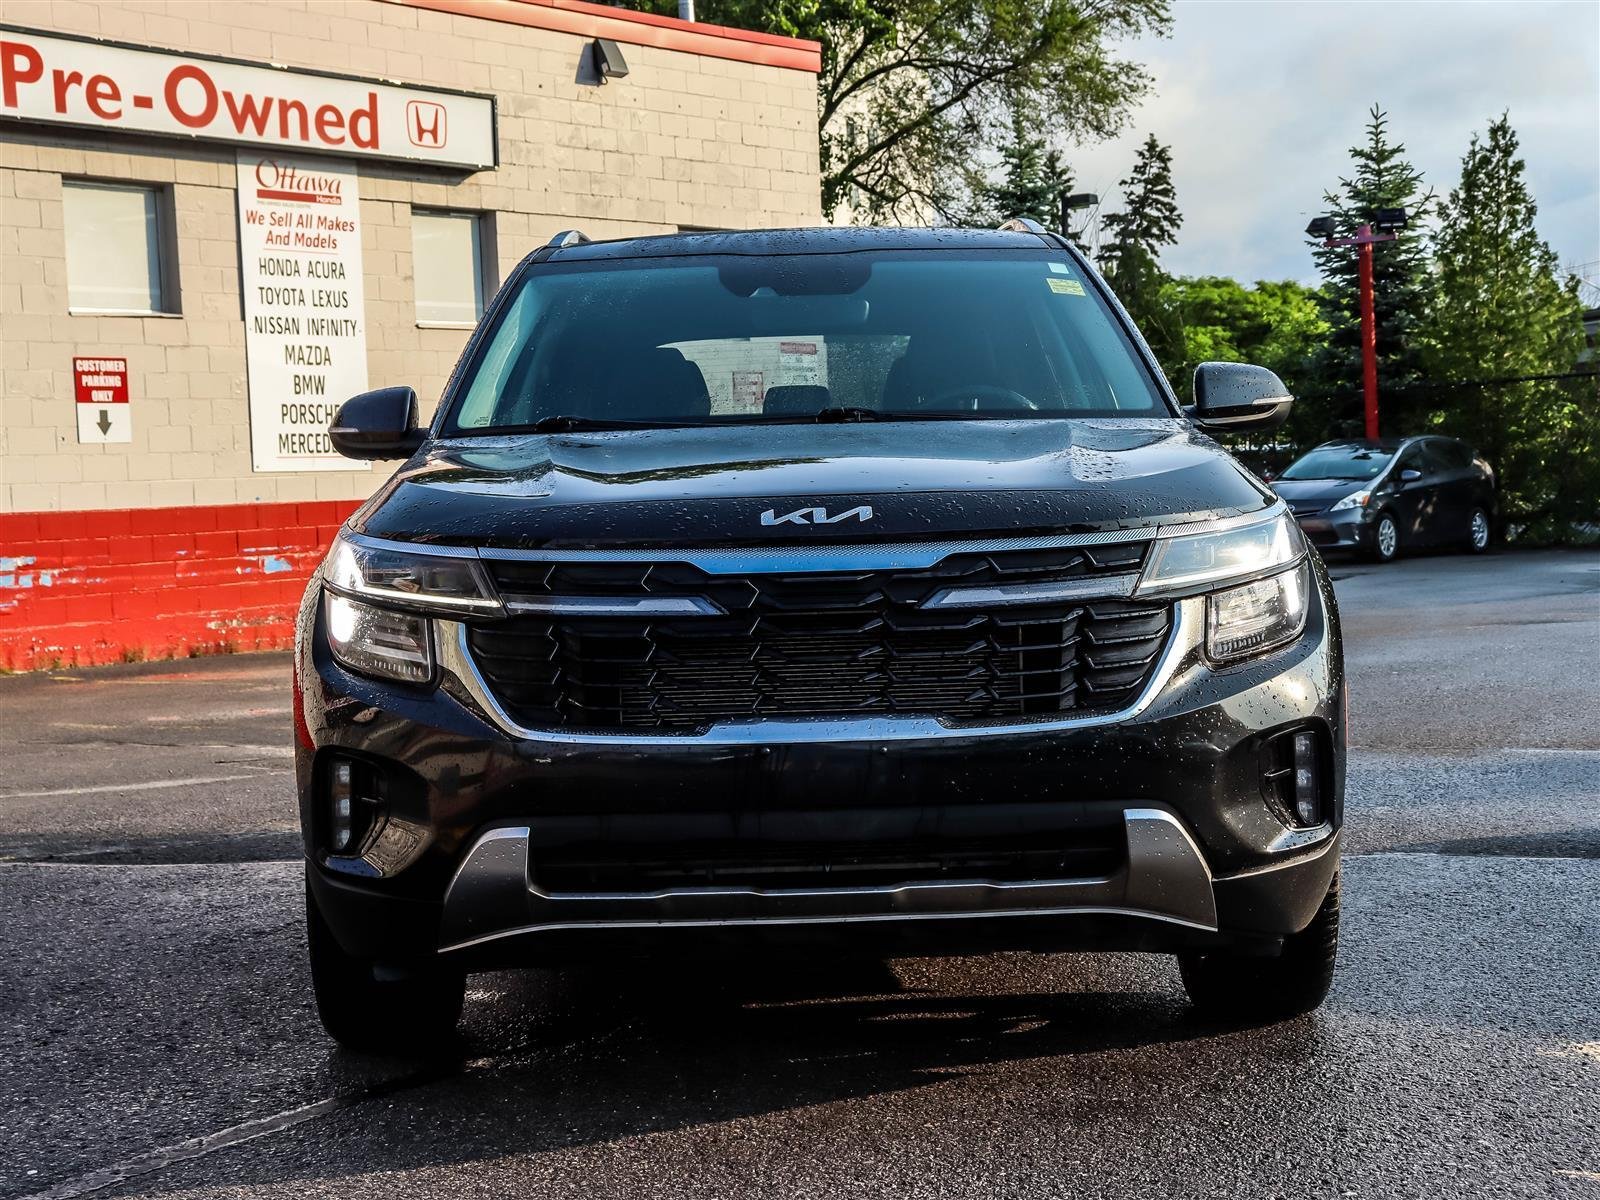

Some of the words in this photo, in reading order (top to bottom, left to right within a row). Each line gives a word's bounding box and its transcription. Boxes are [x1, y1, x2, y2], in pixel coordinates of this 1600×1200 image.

[0, 41, 380, 150] Pre-Owned
[256, 160, 341, 194] Ottawa
[246, 209, 265, 225] We
[269, 211, 292, 227] Sell
[296, 214, 313, 230] All
[317, 215, 355, 232] Makes
[266, 230, 290, 246] And
[294, 233, 337, 249] Models
[258, 257, 301, 277] HONDA
[307, 260, 345, 280] ACURA
[258, 287, 306, 307] TOYOTA
[312, 289, 349, 308] LEXUS
[254, 316, 300, 335] NISSAN
[307, 318, 357, 337] INFINITY
[76, 360, 125, 372] CUSTOMER
[284, 345, 332, 366] MAZDA
[81, 375, 122, 387] PARKING
[293, 375, 325, 395] BMW
[91, 390, 114, 402] ONLY
[278, 433, 338, 454] MERCED
[761, 506, 872, 525] KIA
